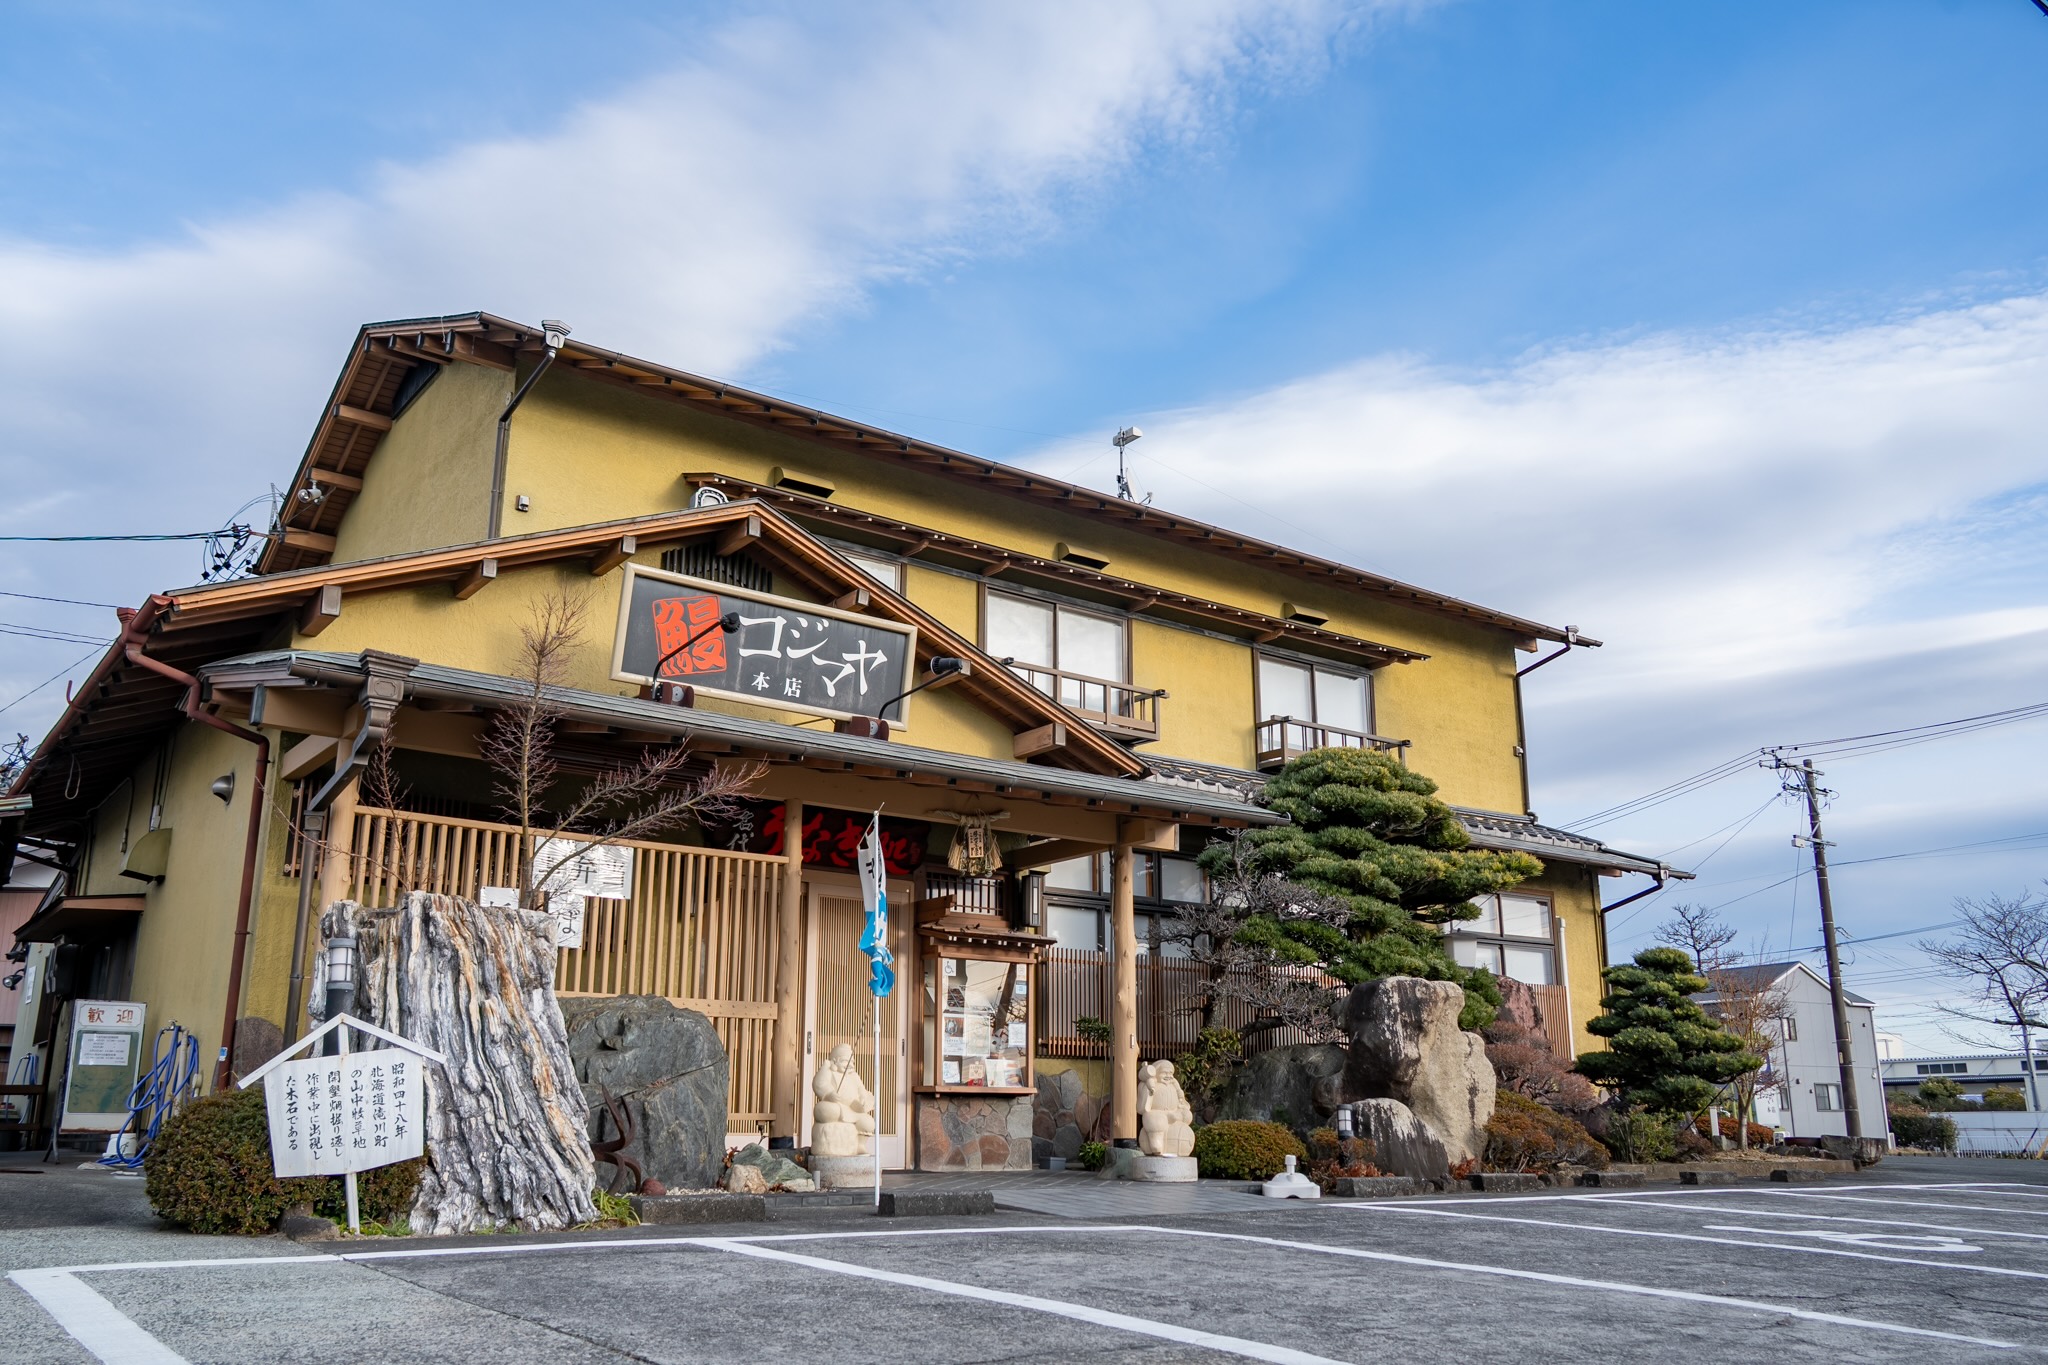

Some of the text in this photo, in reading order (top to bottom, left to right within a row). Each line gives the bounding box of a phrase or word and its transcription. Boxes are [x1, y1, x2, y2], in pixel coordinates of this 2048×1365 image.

[652, 595, 728, 678] 鰻
[738, 614, 888, 698] コジマヤ
[751, 671, 802, 699] 本店
[88, 1007, 134, 1024] 歓迎
[284, 1075, 299, 1151] た木石である
[305, 1072, 323, 1161] 作業中に出現し
[350, 1069, 367, 1150] の山中牧草地
[370, 1065, 389, 1149] 北海道滝川町
[391, 1062, 409, 1140] 昭和四十八年
